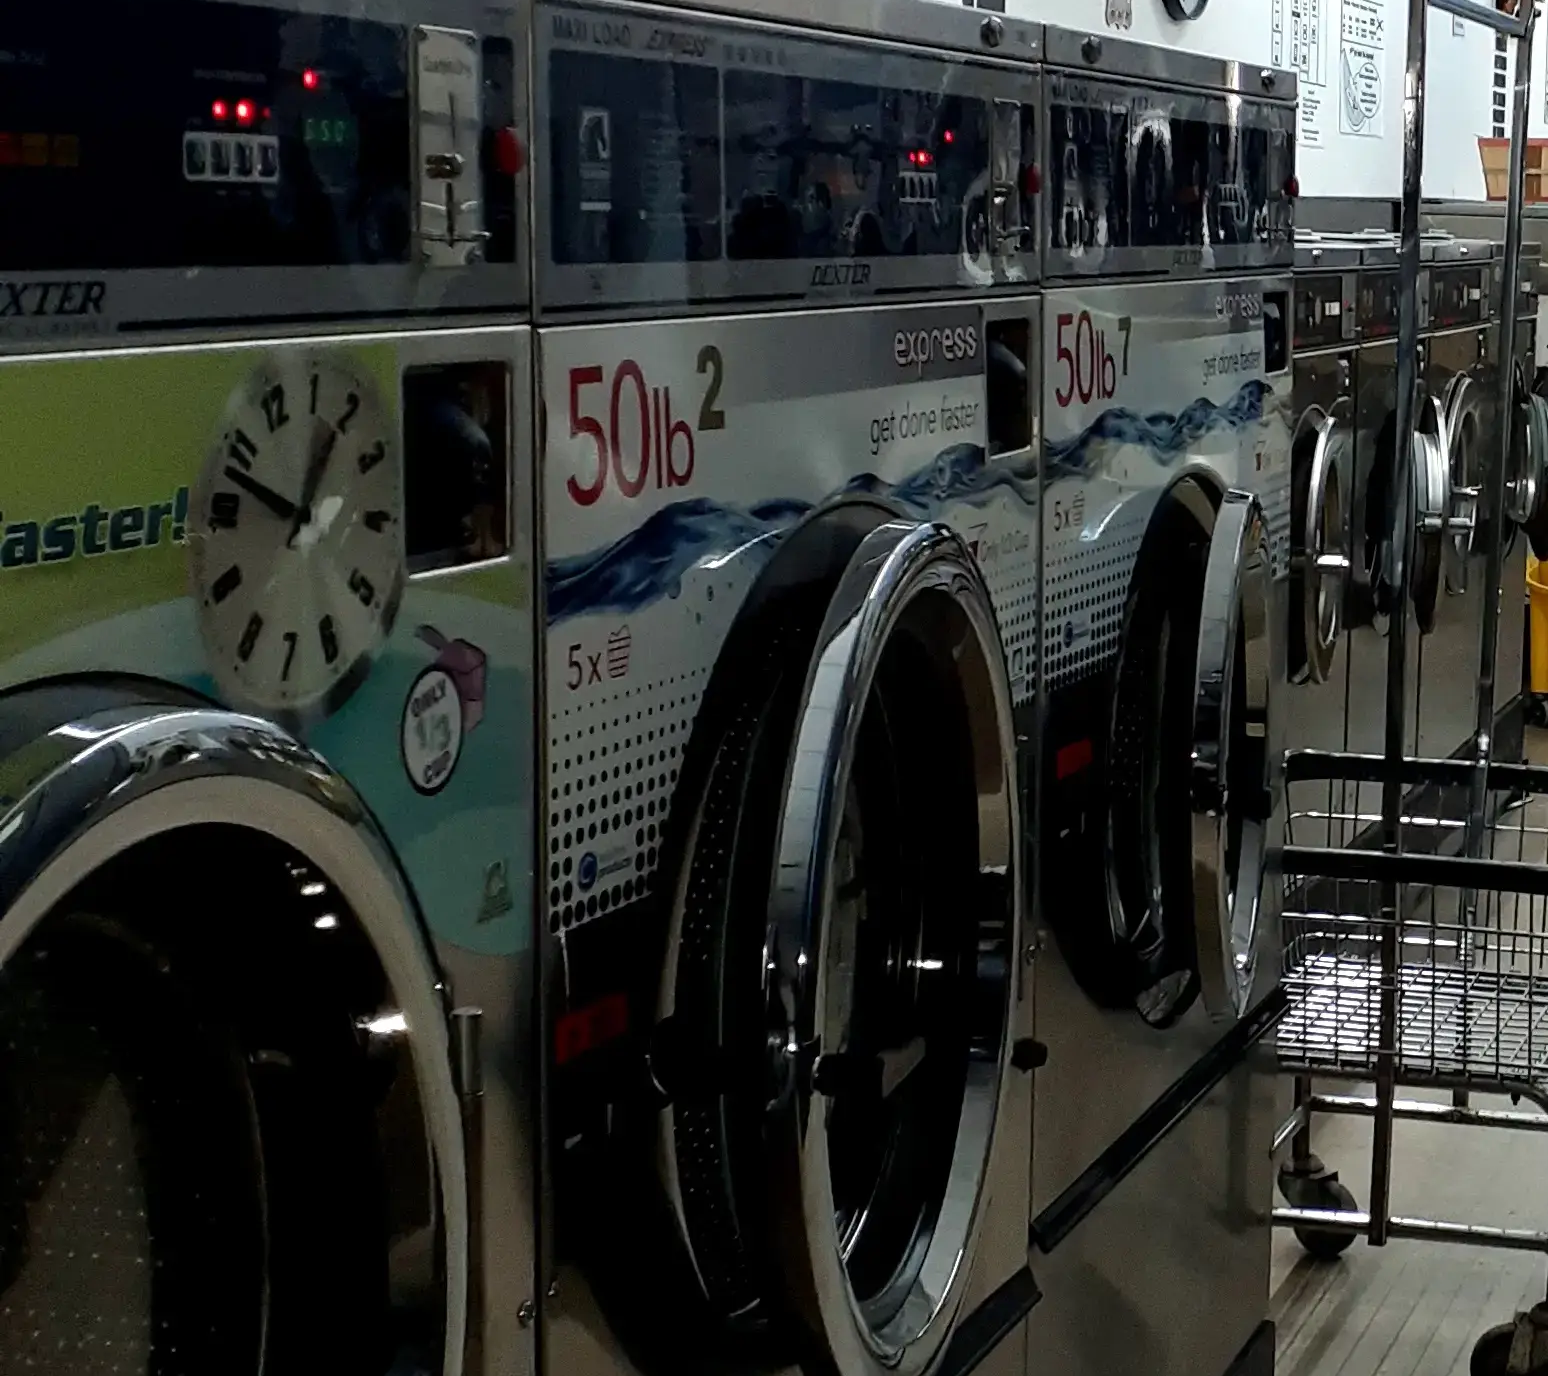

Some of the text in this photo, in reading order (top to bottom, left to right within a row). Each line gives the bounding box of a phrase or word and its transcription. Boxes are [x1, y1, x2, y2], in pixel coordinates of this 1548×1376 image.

[810, 262, 871, 286] DEXTER
[1216, 293, 1260, 321] express
[894, 325, 978, 377] express
[1056, 310, 1116, 408] 50lb
[260, 383, 290, 434] 12
[309, 373, 319, 416] 1
[696, 344, 726, 432] 2
[337, 390, 361, 436] 2
[566, 358, 695, 507] 50lb
[870, 394, 980, 456] get done faster
[227, 428, 259, 473] 11
[357, 439, 386, 475] 3
[0, 485, 189, 568] aster!
[410, 677, 447, 718] ONLY
